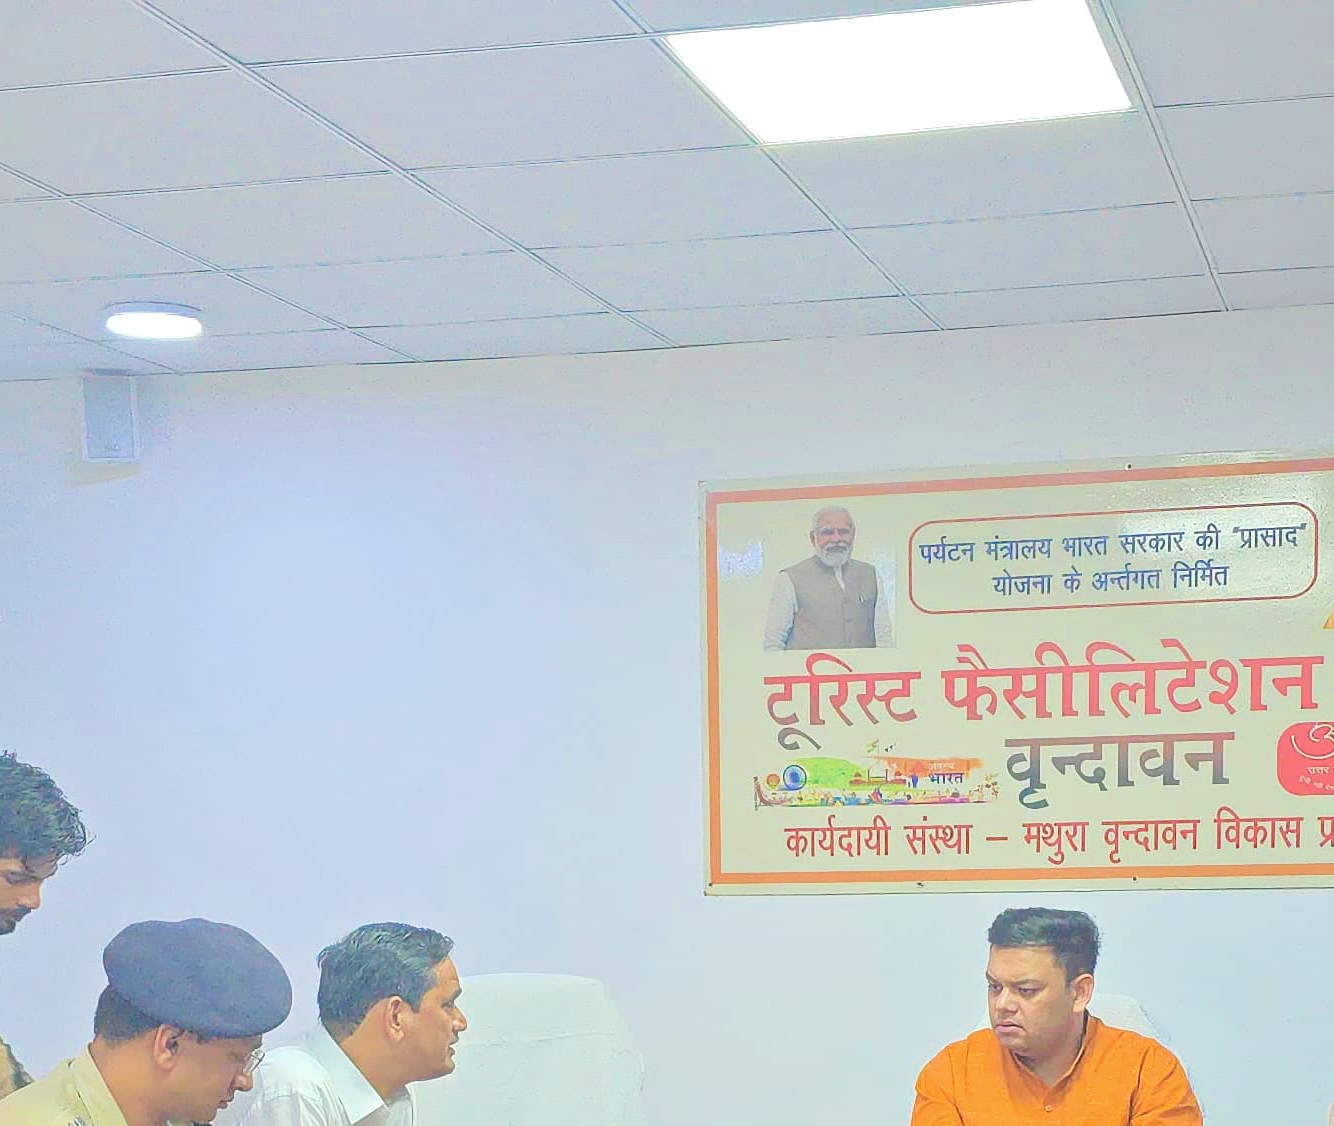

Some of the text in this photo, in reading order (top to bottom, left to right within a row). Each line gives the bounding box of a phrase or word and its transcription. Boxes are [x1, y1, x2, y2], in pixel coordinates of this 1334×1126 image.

[918, 536, 976, 564] पर्यटन
[984, 535, 1053, 561] मंत्रालय
[1061, 535, 1110, 558] भारत
[1118, 531, 1185, 553] सरकार
[1194, 523, 1221, 550] की
[992, 569, 1053, 596] योजना
[1061, 565, 1082, 593] के
[1171, 559, 1230, 589] निर्मित
[763, 652, 922, 750] टूरिस्ट
[940, 639, 1325, 721] फैसीलिटेशन
[928, 772, 964, 784] भारत
[1004, 731, 1235, 810] वृन्दावन
[784, 815, 891, 857] कार्यदायी
[903, 816, 973, 855] संस्था
[1022, 821, 1089, 865] मथुरा
[1101, 819, 1200, 863] वृन्दावन
[1214, 806, 1304, 850] विकास
